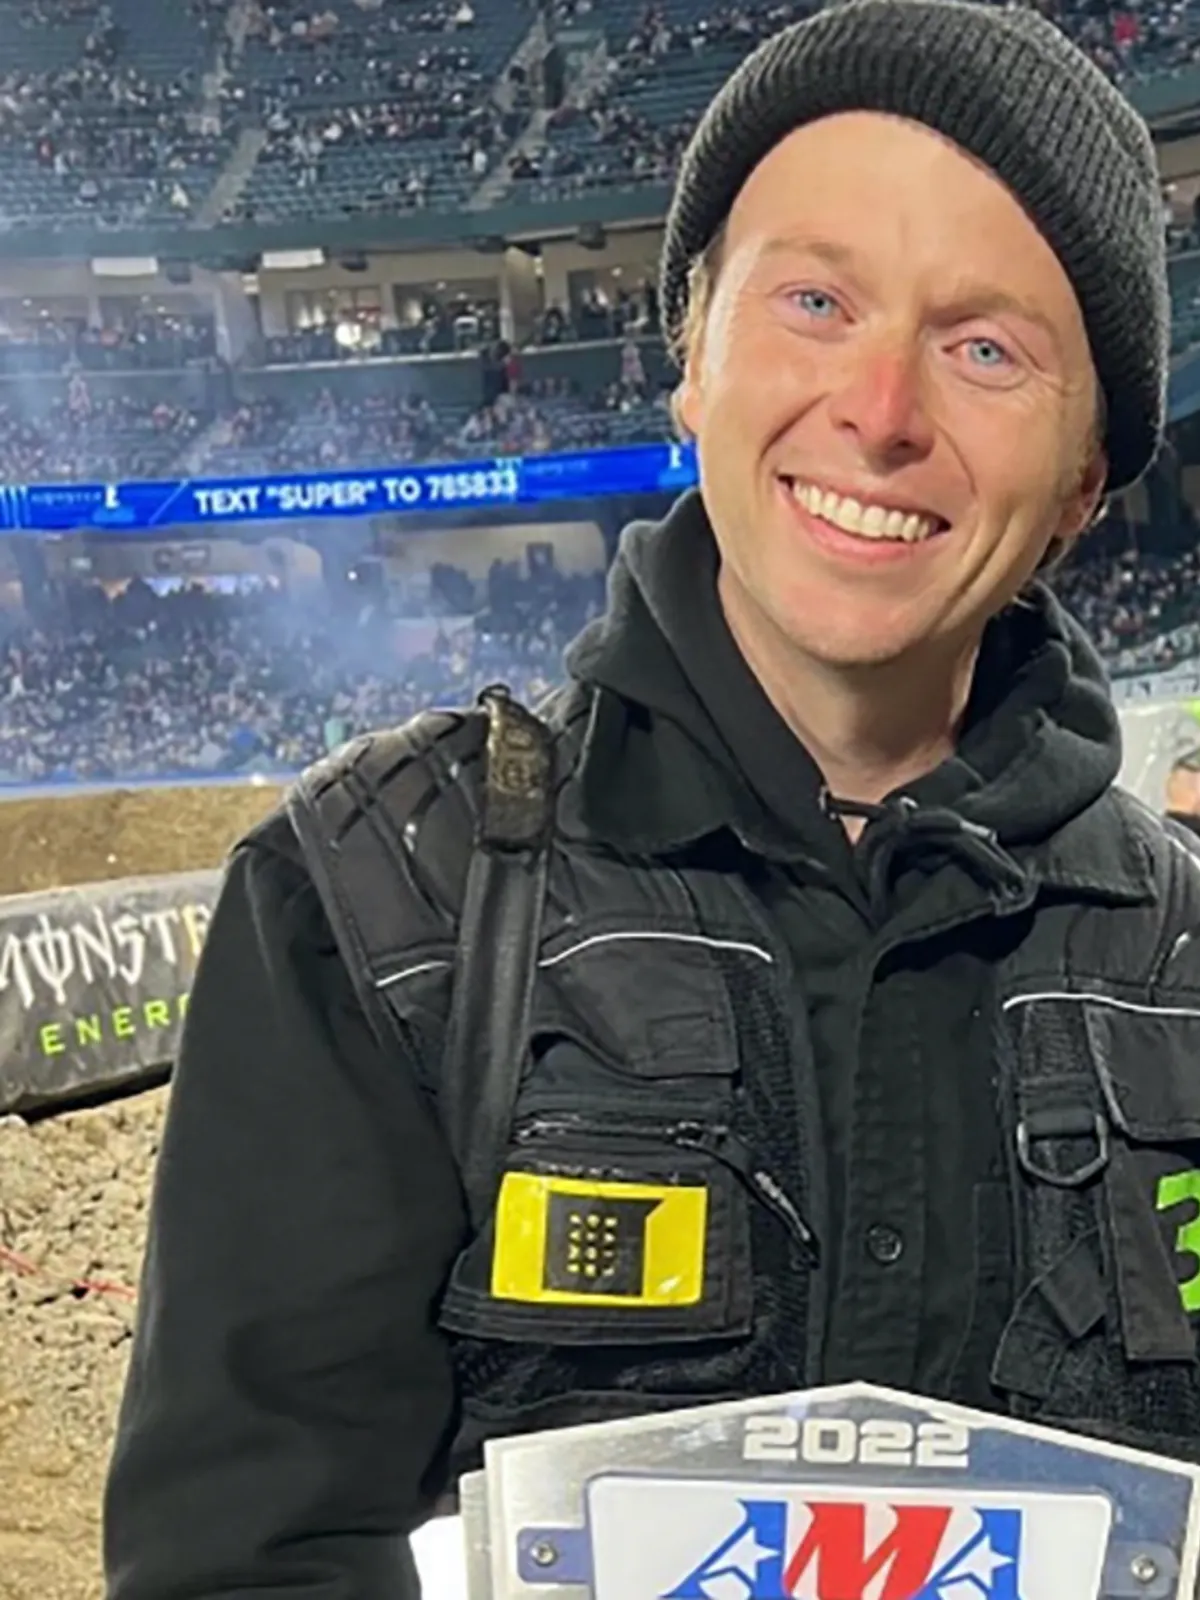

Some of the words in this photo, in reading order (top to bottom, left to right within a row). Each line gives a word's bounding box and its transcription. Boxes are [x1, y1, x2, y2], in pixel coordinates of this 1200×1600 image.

[193, 485, 262, 515] TEXT
[266, 478, 377, 511] "SUPER"
[382, 475, 421, 503] TO
[742, 1415, 970, 1468] 2022
[657, 1498, 1028, 1600] AMA
